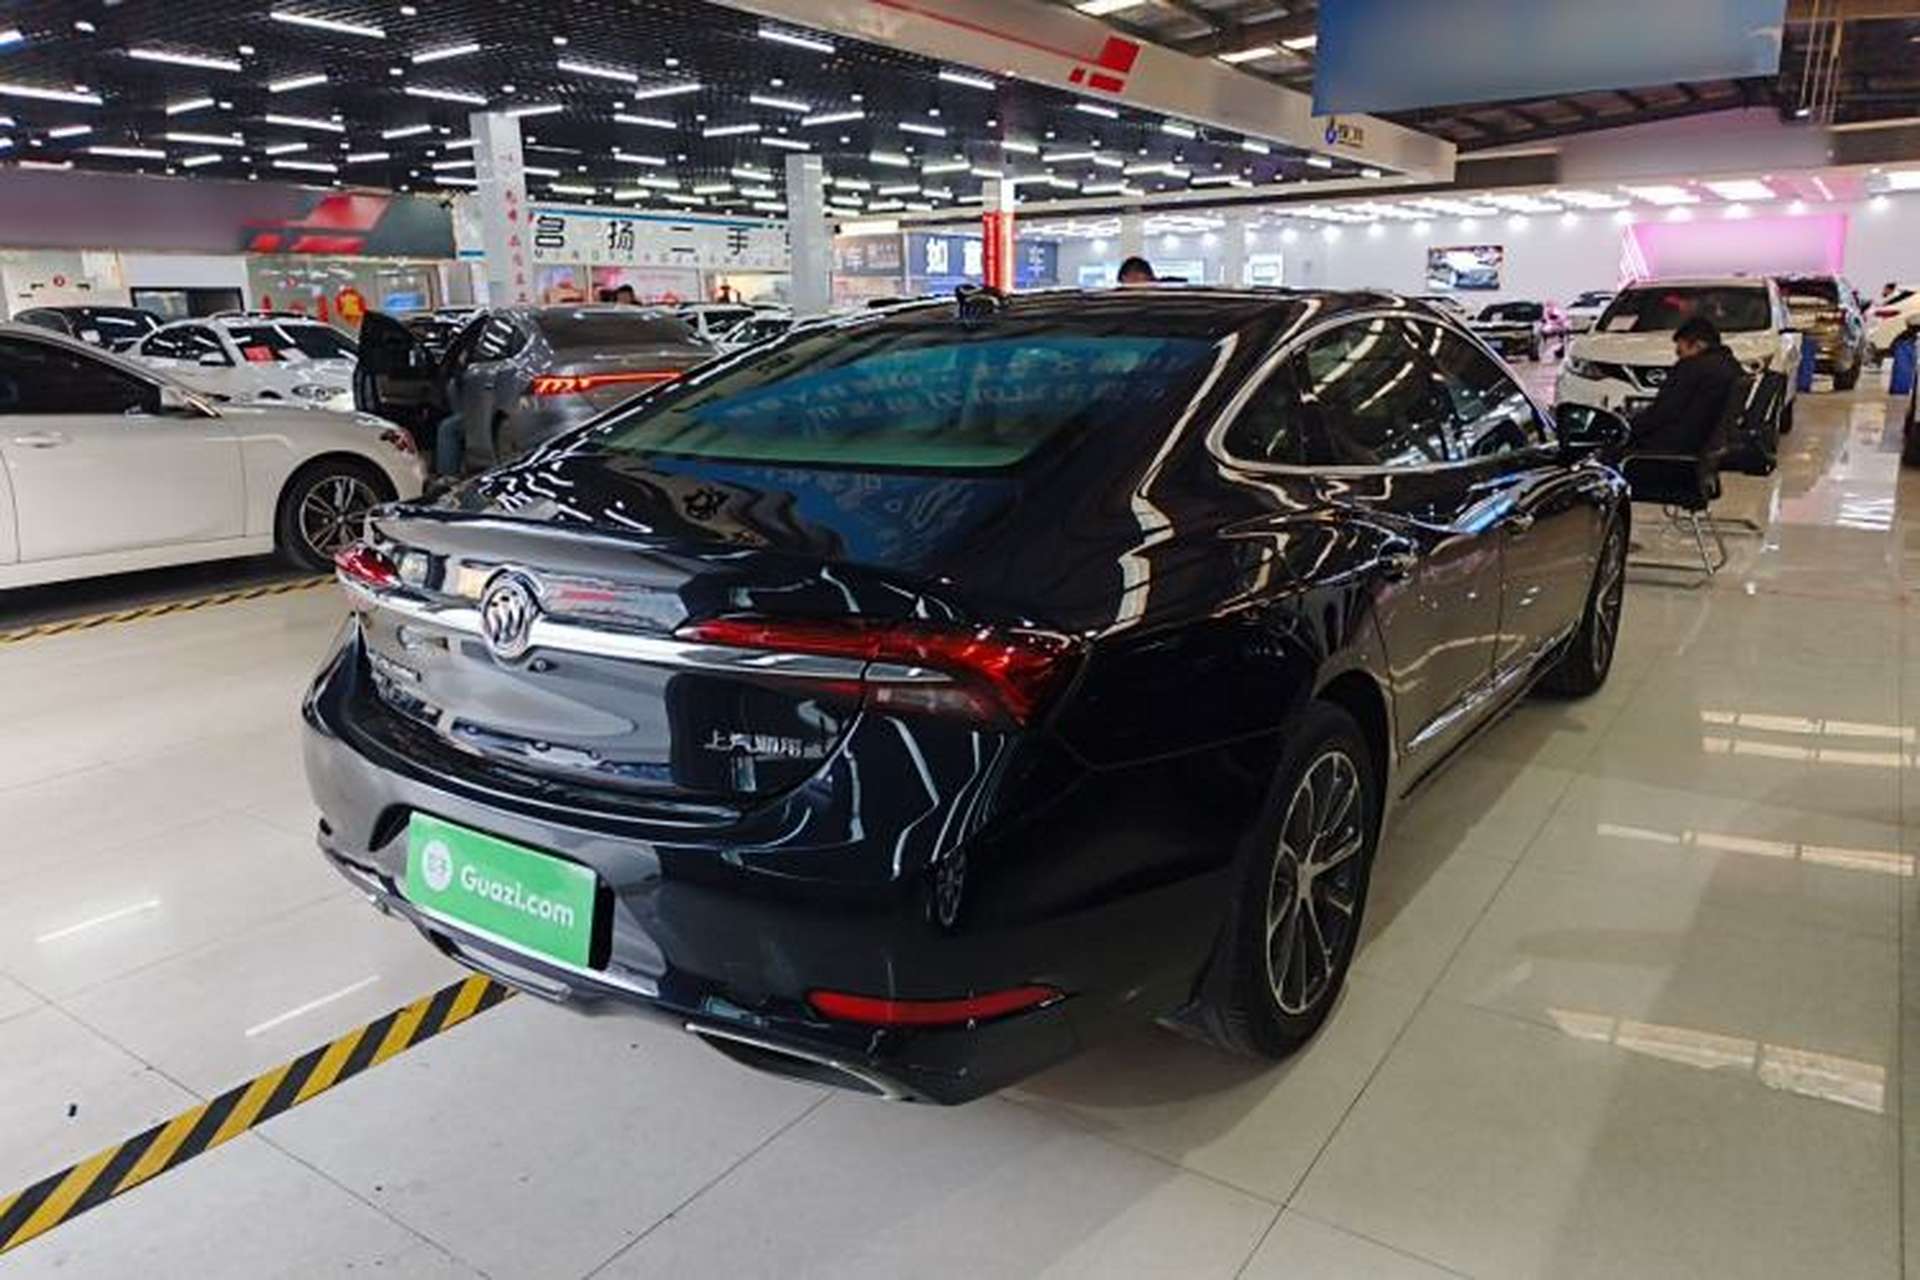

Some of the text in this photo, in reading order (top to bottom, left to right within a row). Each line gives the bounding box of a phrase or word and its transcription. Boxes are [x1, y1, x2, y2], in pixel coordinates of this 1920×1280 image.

[534, 215, 790, 255] 名扬二手
[460, 864, 575, 928] Guazi.com
